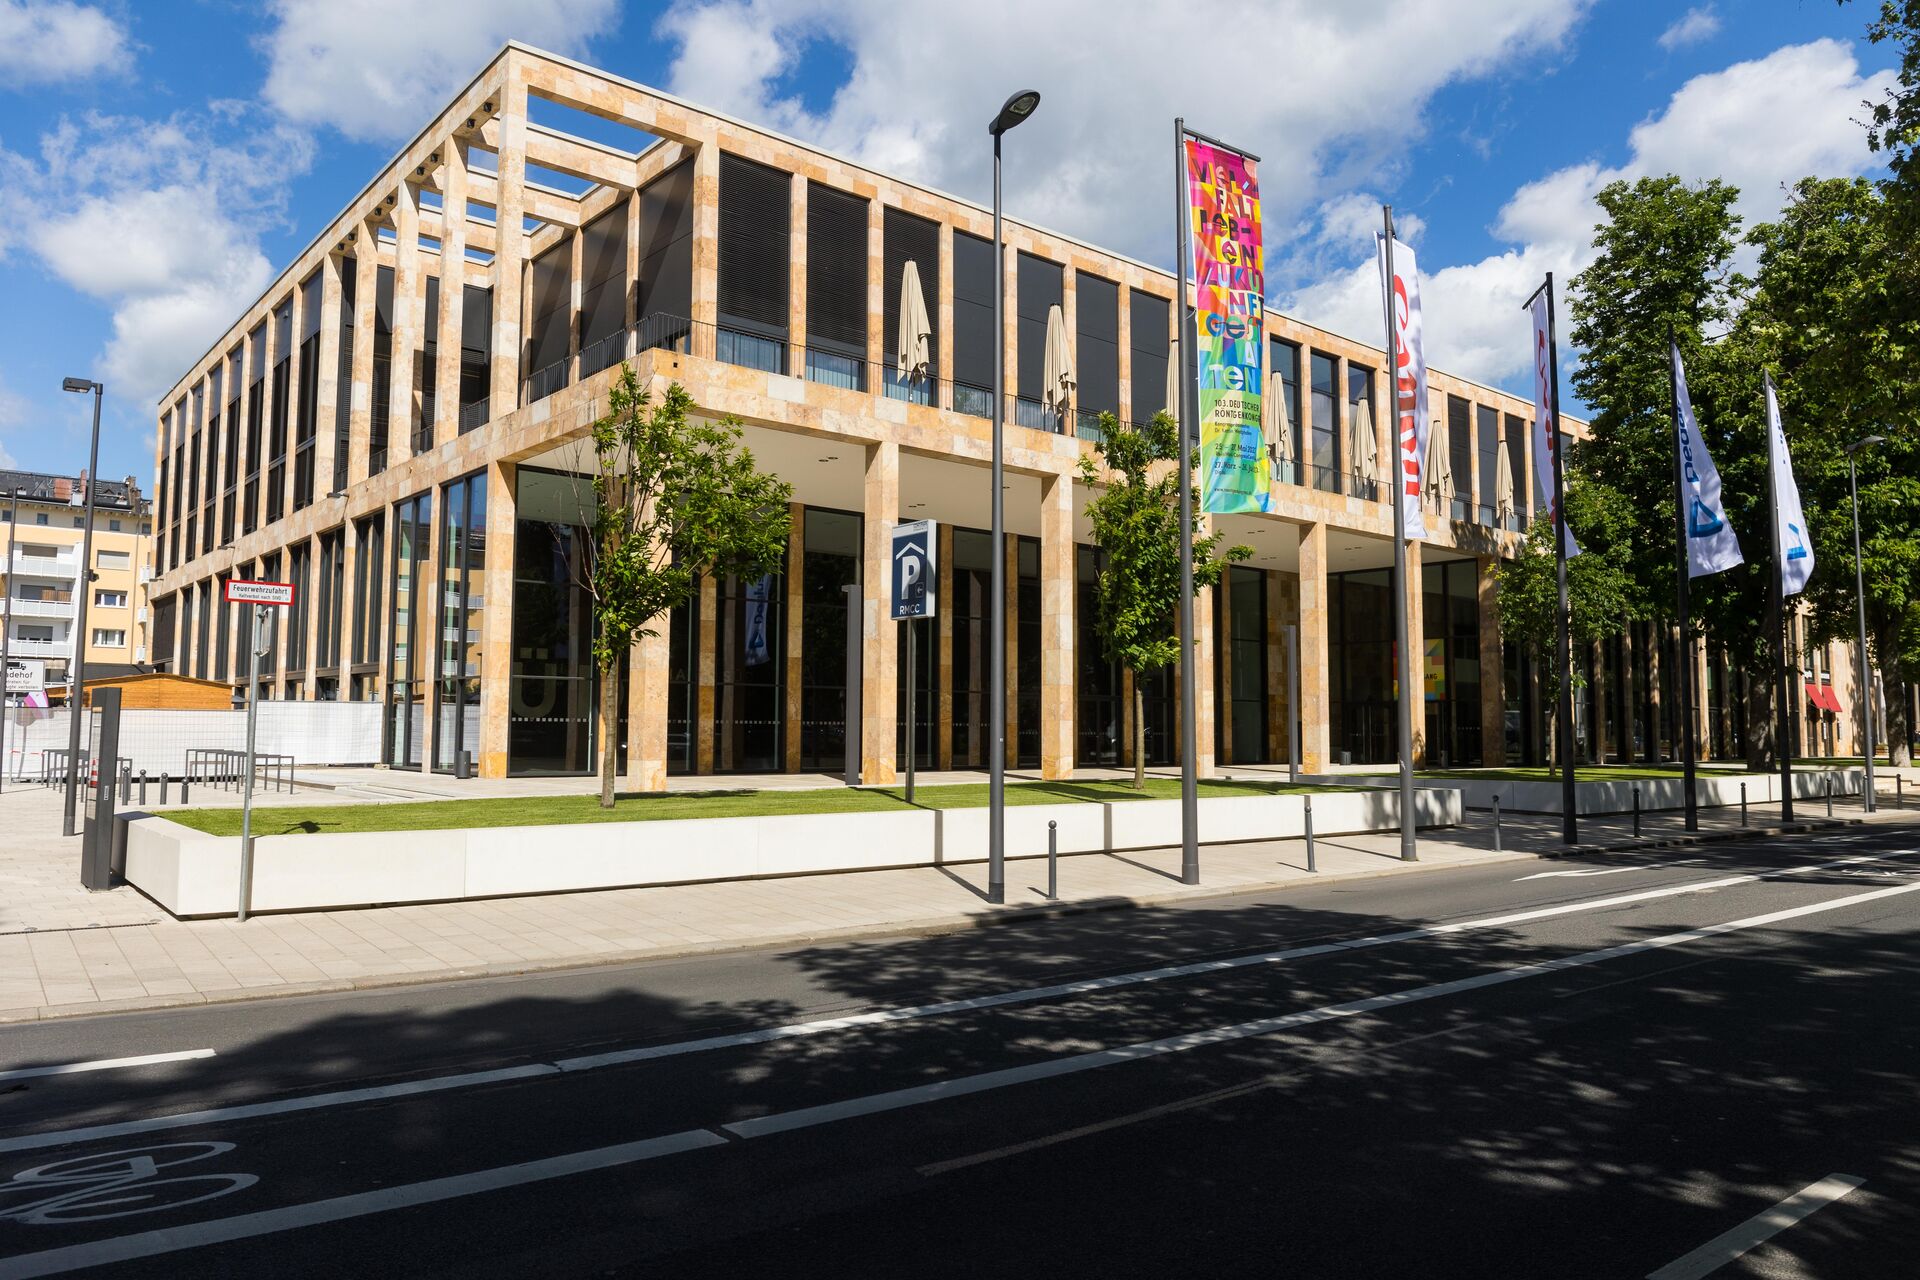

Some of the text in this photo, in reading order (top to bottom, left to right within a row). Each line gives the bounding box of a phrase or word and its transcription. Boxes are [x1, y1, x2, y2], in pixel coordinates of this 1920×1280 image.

[1230, 400, 1259, 412] DEUTSCHER
[902, 555, 920, 600] P
[233, 584, 288, 595] Feuerwehrzufahrt
[900, 603, 920, 615] RMCC
